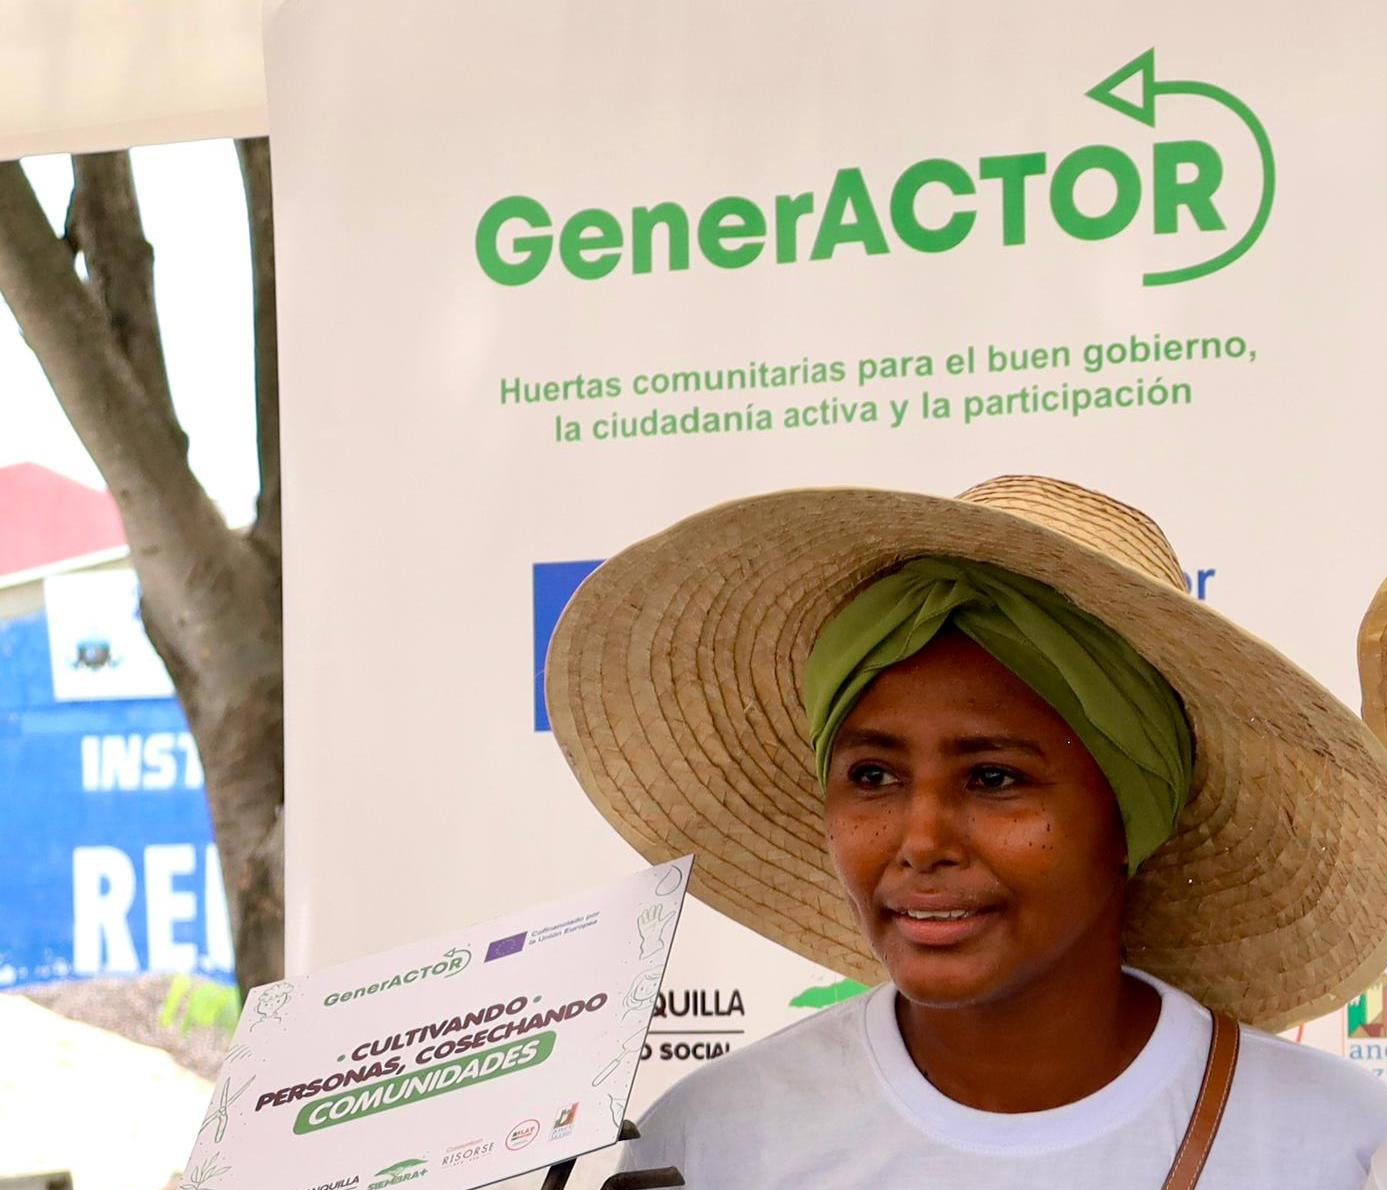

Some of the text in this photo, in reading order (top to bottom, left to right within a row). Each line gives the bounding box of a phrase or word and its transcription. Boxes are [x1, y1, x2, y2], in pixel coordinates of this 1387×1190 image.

[475, 140, 1226, 286] GenerACTOR
[499, 334, 1257, 404] Huertas comunitarias para el buen gobierno,
[555, 376, 1192, 442] la ciudadanía activa y la participación
[323, 957, 463, 1007] GenerACTOR
[255, 992, 608, 1112] PERSONAS, COSECHANDO
[351, 996, 528, 1062] CULTIVANDO
[308, 1039, 540, 1126] COMUNIDADES
[441, 1142, 495, 1166] RISORSE
